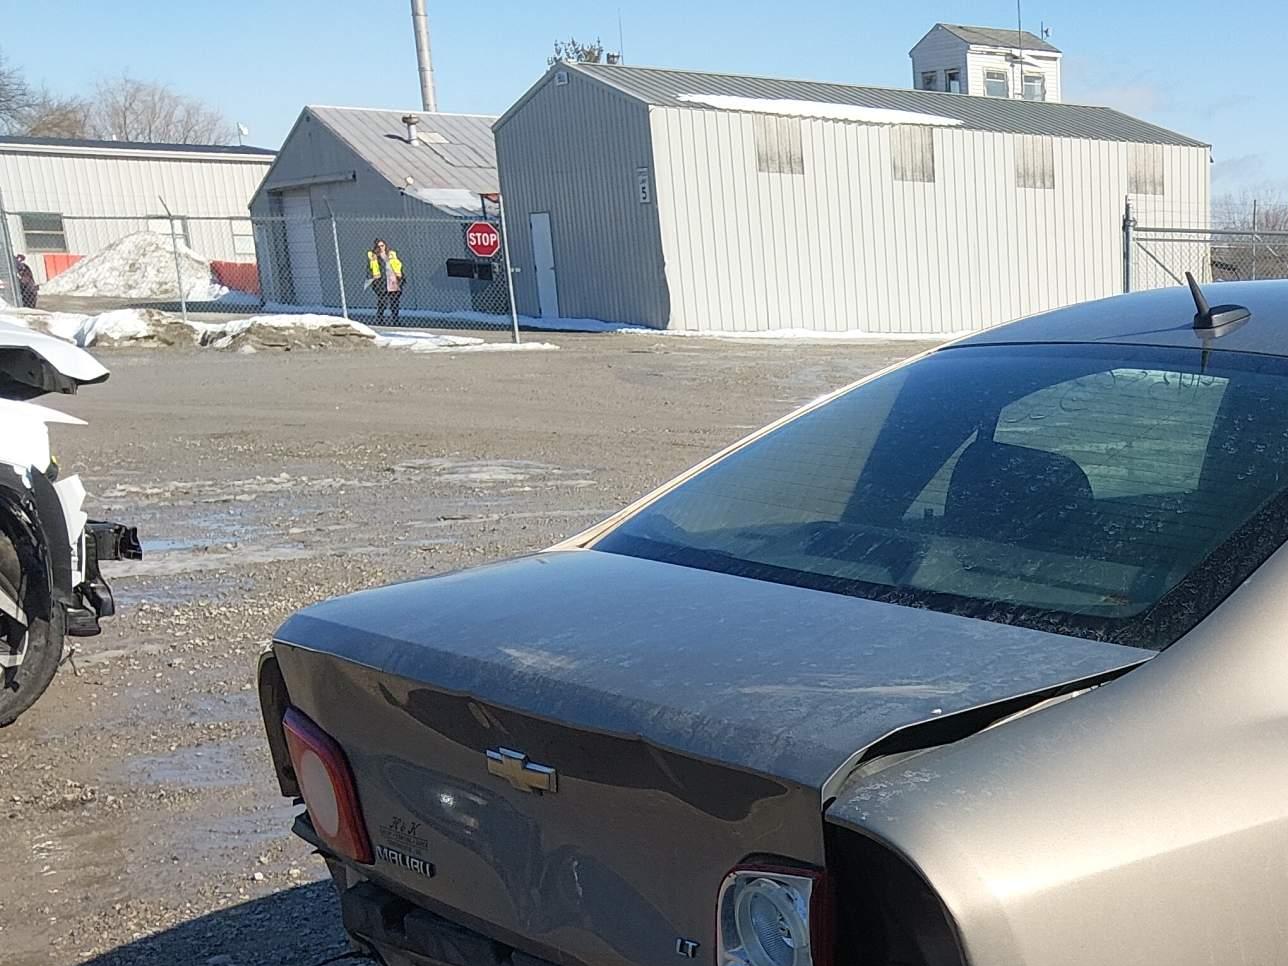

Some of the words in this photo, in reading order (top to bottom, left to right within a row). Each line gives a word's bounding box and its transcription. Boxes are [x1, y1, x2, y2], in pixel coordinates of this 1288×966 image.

[469, 232, 497, 246] STOP
[376, 845, 433, 878] MALIBU
[676, 938, 699, 958] LT
